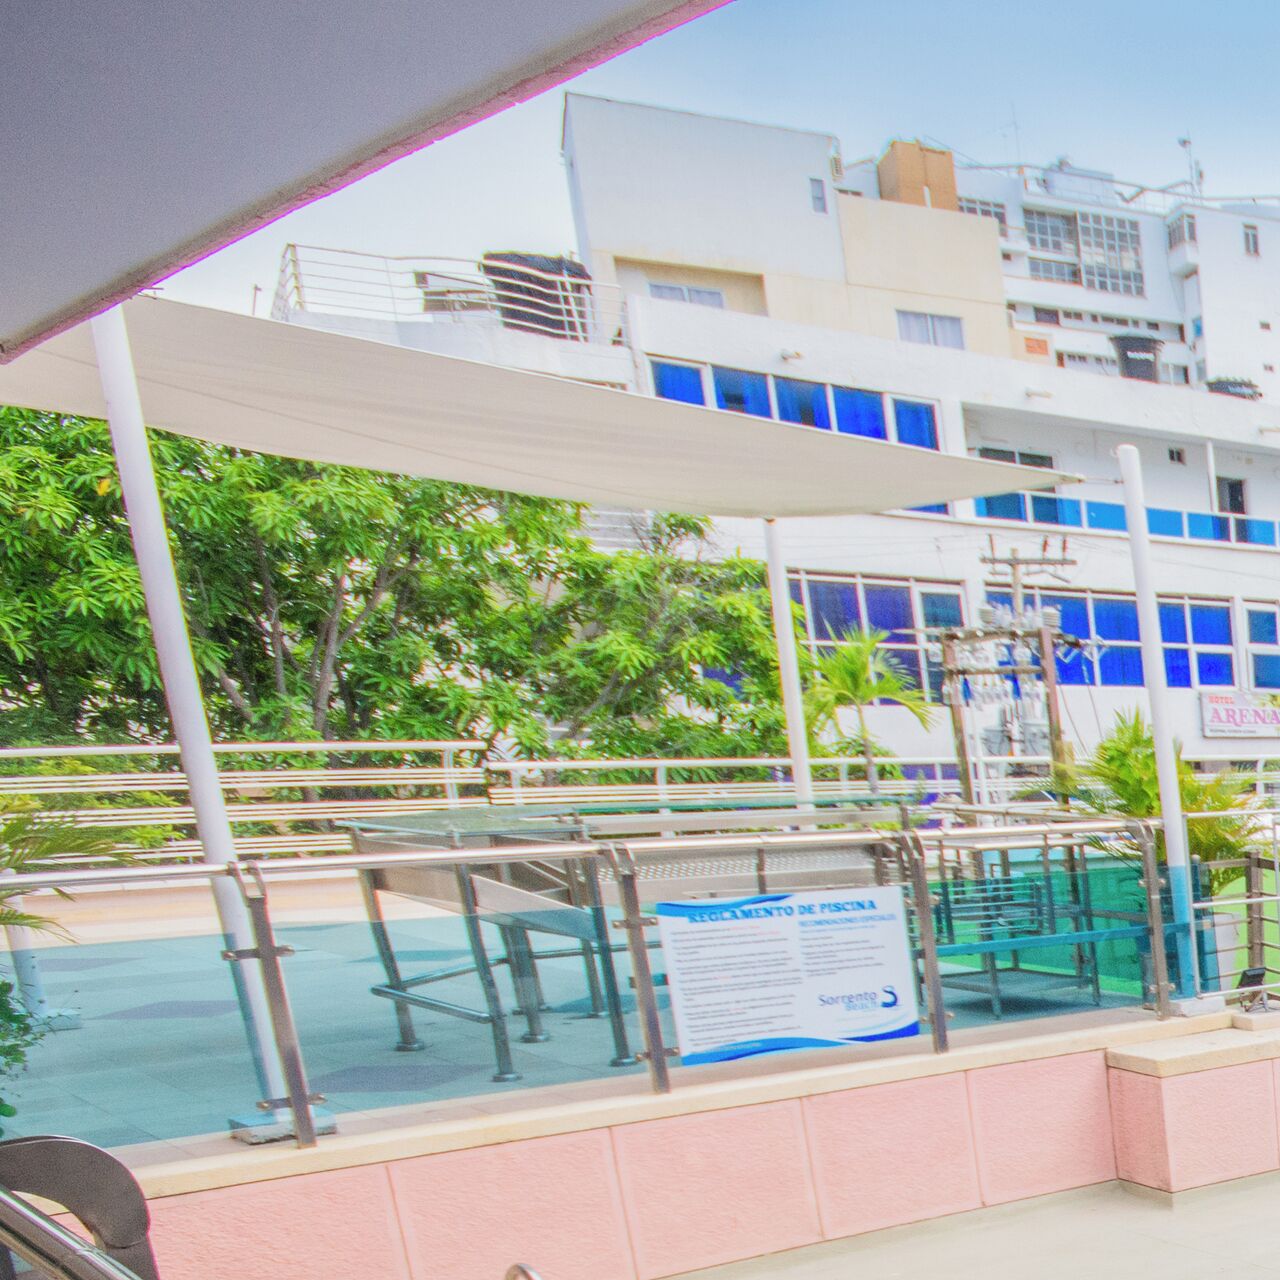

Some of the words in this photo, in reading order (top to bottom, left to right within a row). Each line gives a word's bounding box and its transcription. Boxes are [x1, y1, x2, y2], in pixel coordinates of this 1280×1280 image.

[688, 905, 794, 923] REGLAMENTO
[798, 904, 817, 915] DE
[820, 900, 877, 913] PISCINA
[818, 991, 877, 1007] Sorrento
